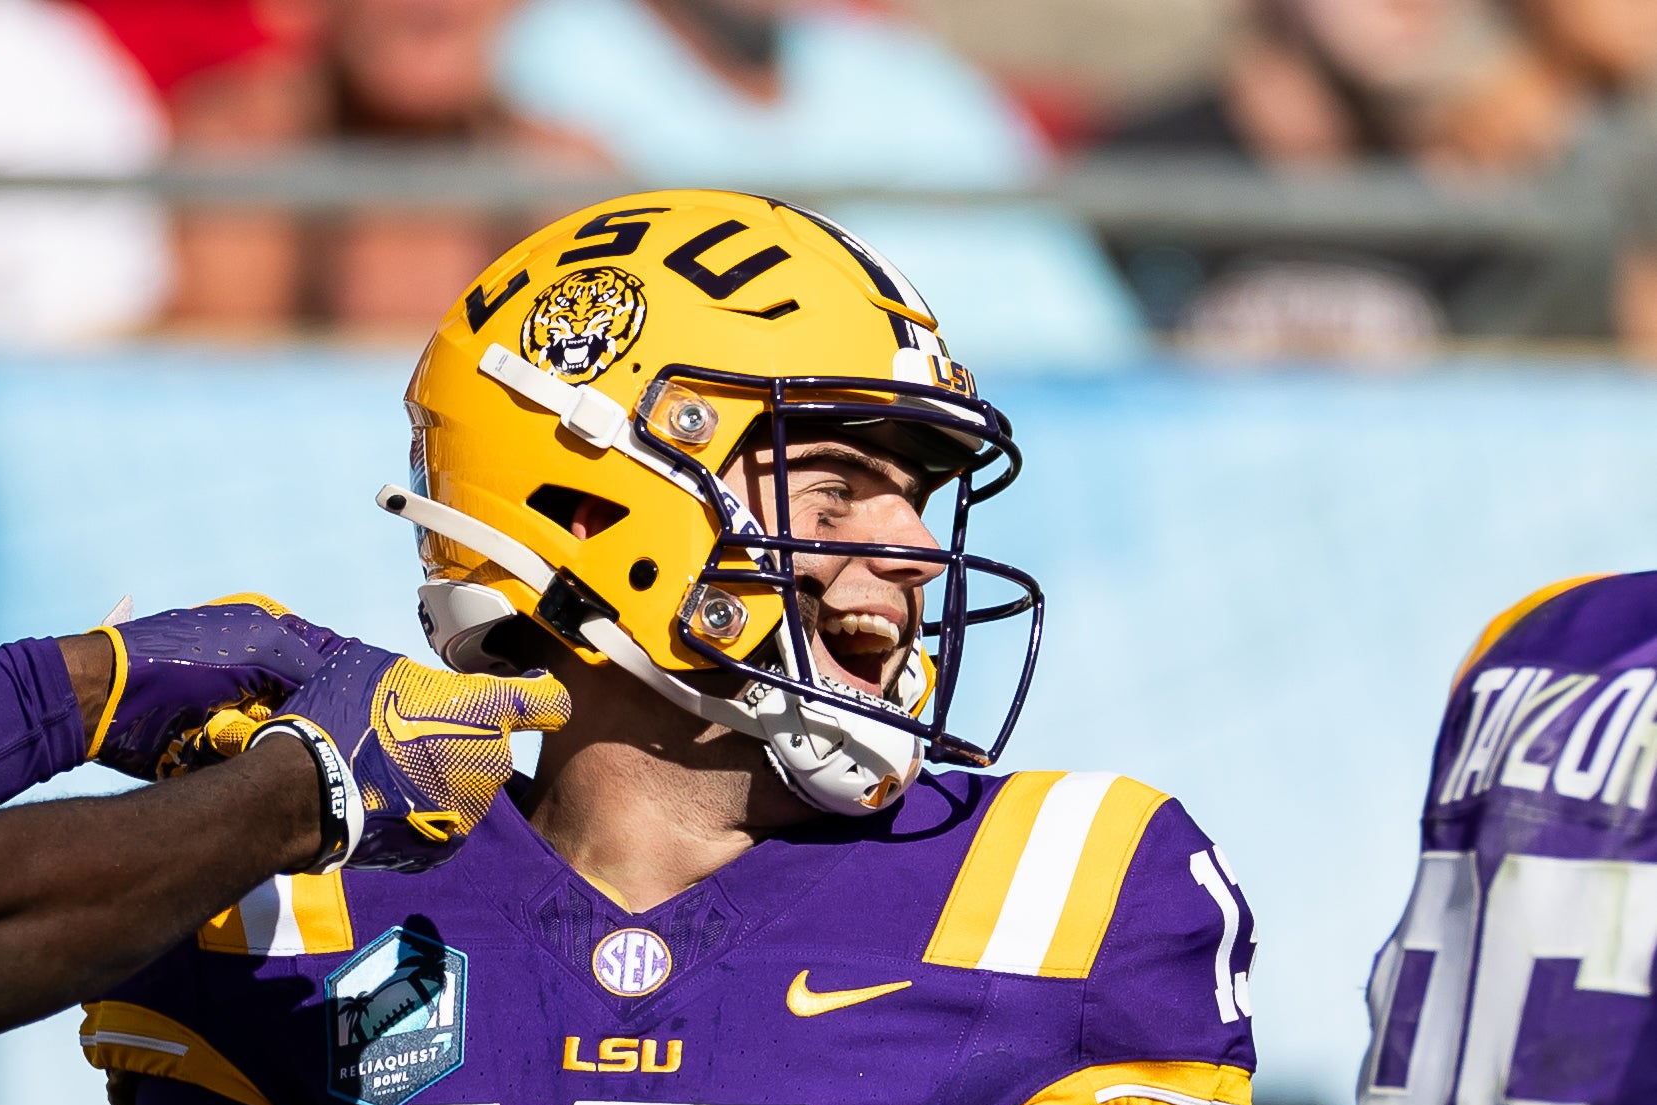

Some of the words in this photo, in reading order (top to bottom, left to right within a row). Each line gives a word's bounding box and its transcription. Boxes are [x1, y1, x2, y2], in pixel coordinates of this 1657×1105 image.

[464, 207, 791, 334] LSU
[315, 741, 341, 784] MORE
[330, 785, 345, 820] REP
[601, 932, 666, 992] SEC
[340, 1046, 439, 1079] RELIAQUEST
[563, 1036, 683, 1073] LSU
[373, 1071, 409, 1089] BOWL
